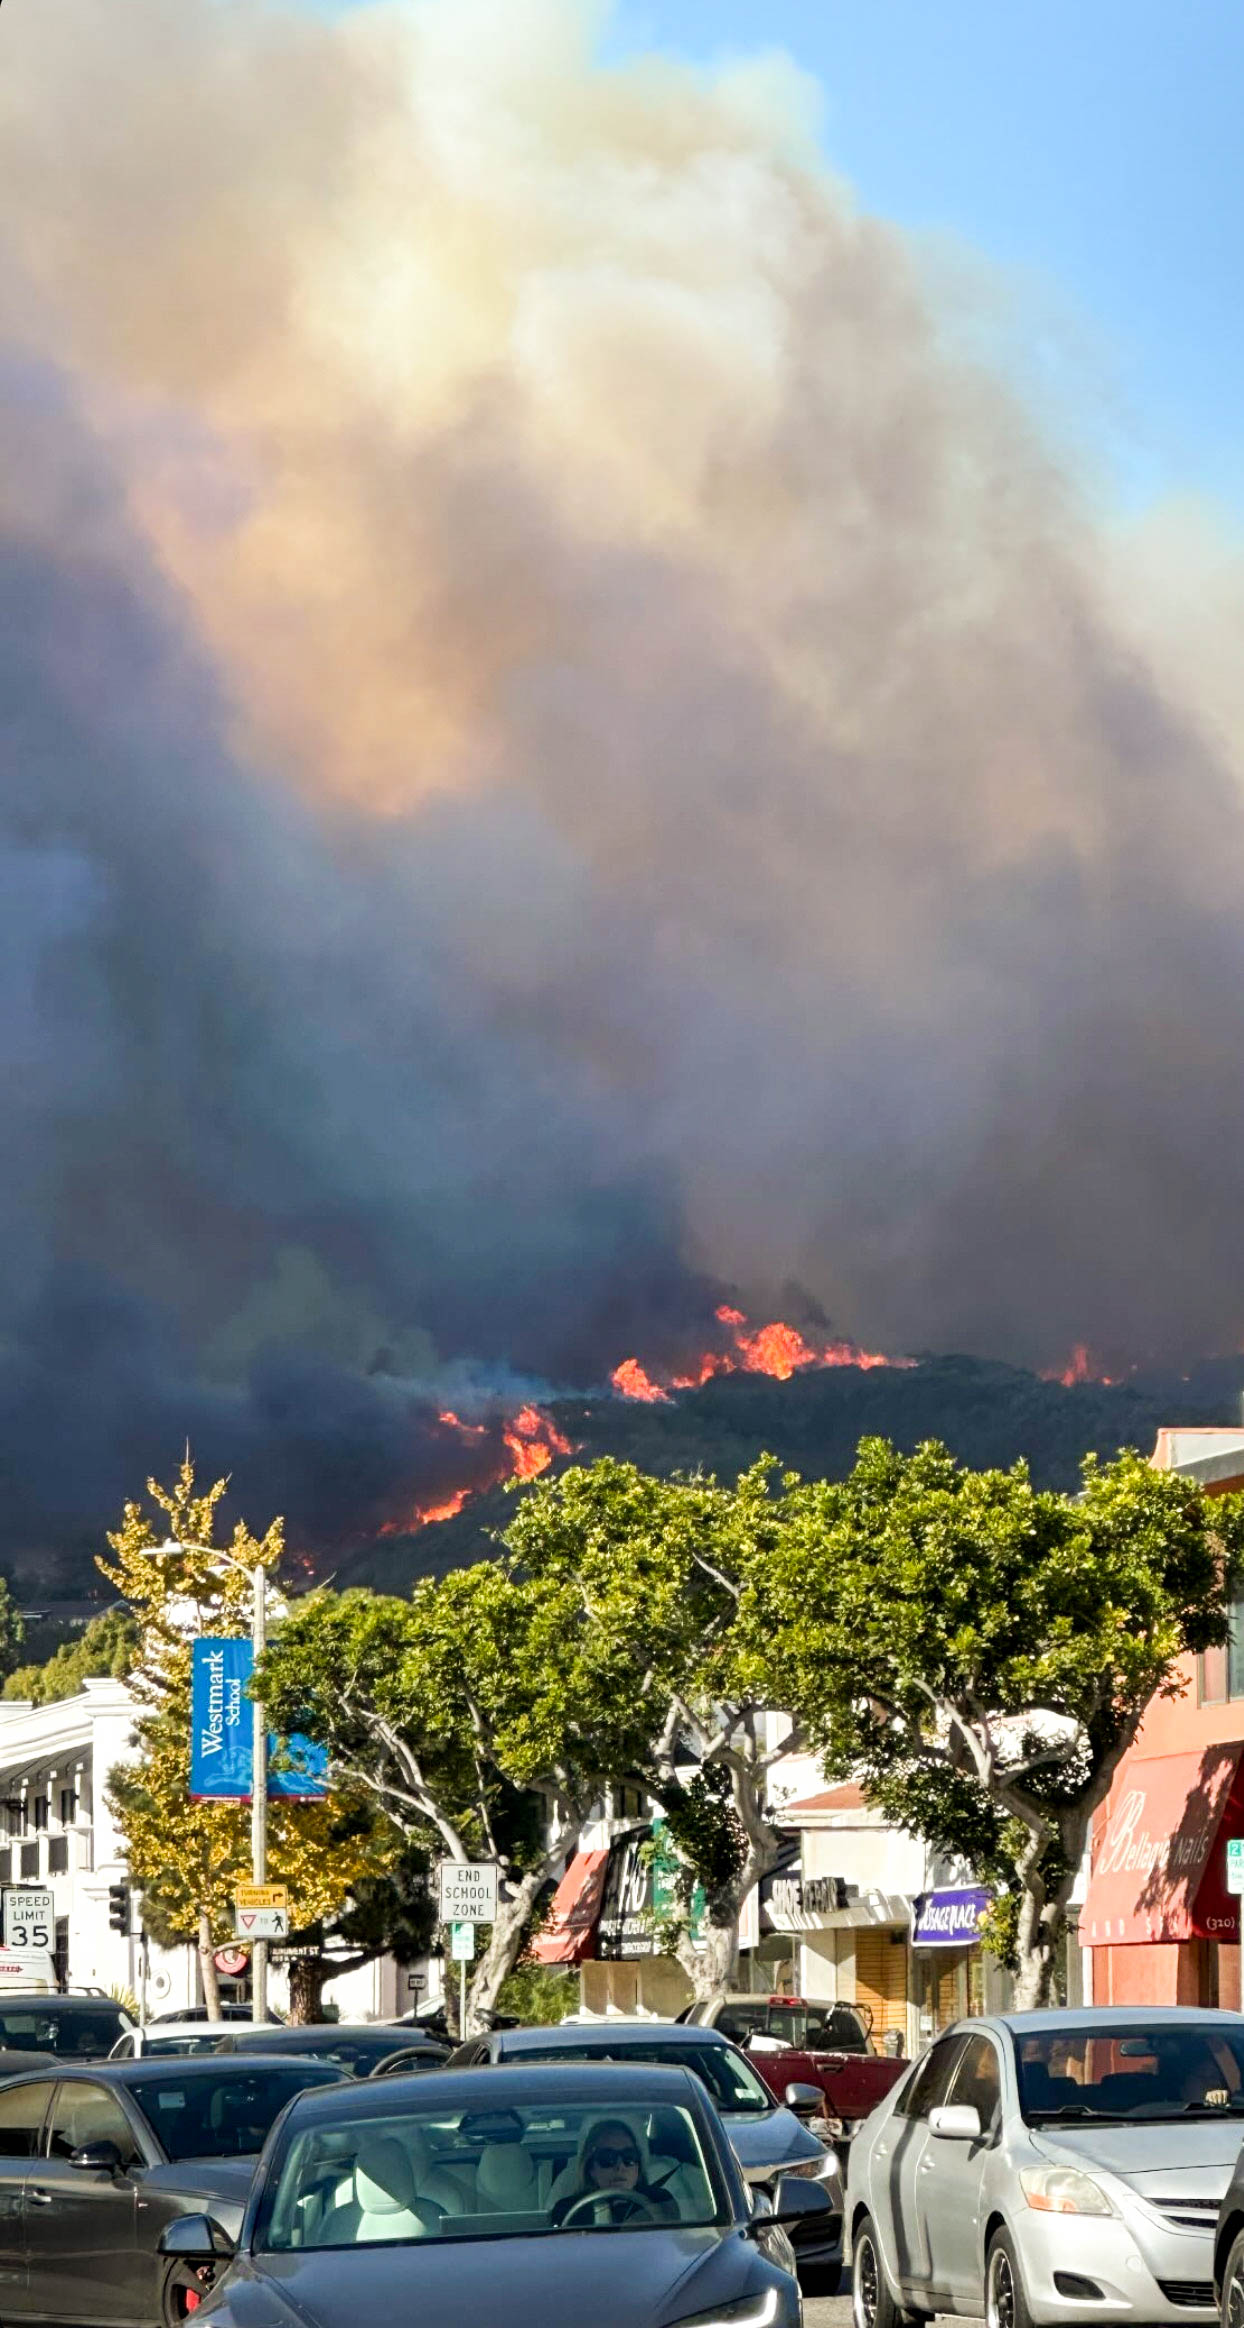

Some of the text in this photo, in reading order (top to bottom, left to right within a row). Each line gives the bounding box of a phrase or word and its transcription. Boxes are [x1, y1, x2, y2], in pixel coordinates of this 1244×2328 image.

[201, 1650, 224, 1758] Westmark
[225, 1678, 241, 1726] School
[1173, 1828, 1210, 1866] Nails
[458, 1870, 480, 1881] END
[445, 1886, 492, 1899] SCHOOL
[10, 1896, 50, 1906] SPEED
[13, 1911, 45, 1920] LIMIT
[453, 1904, 484, 1916] ZONE
[11, 1925, 49, 1947] 35
